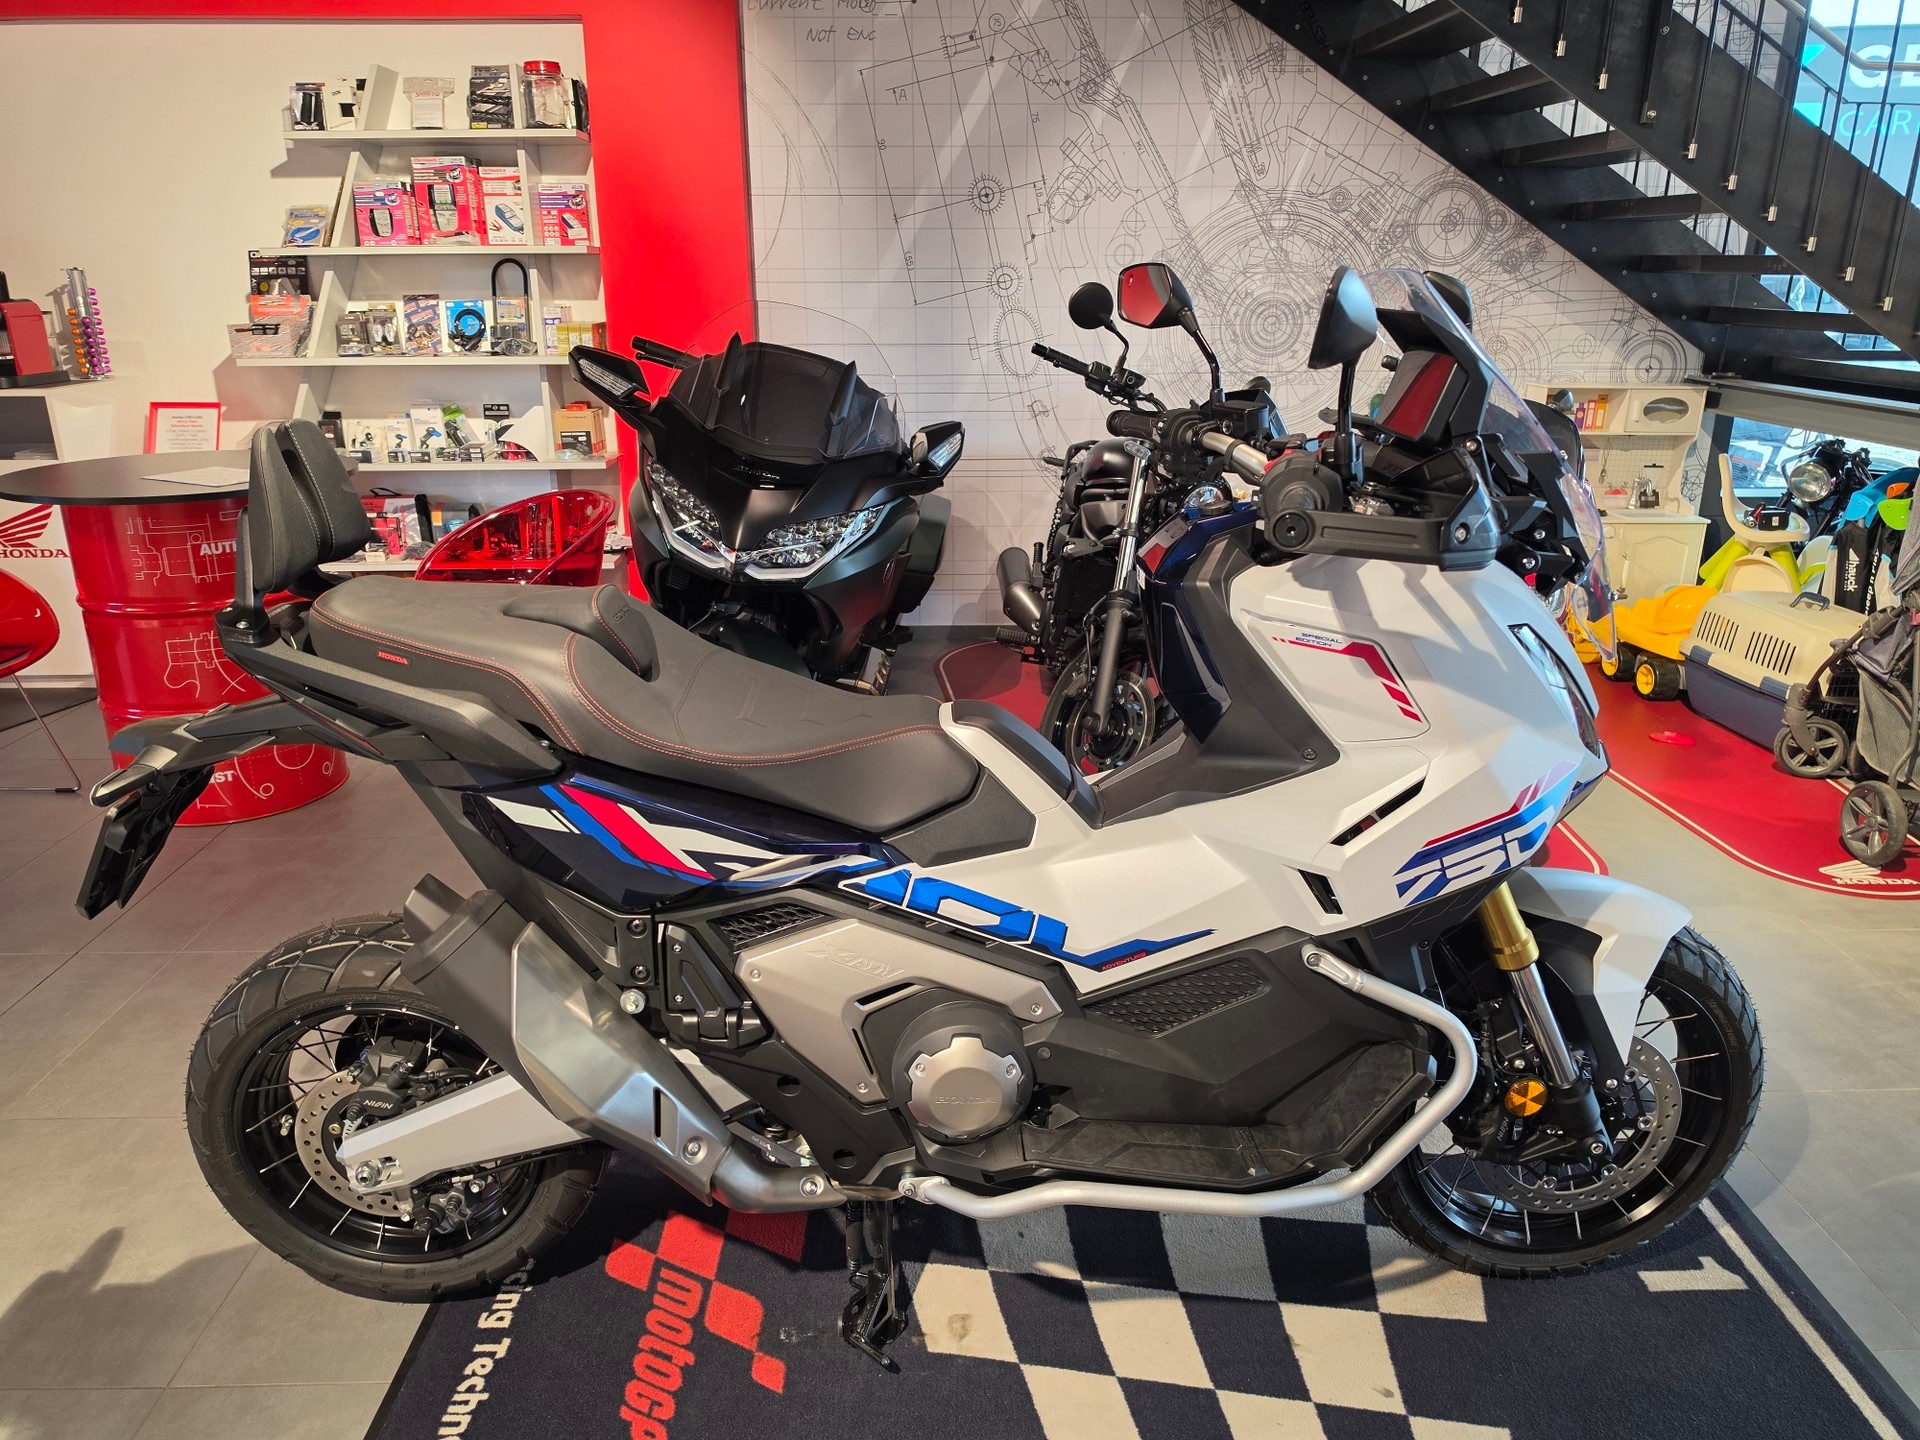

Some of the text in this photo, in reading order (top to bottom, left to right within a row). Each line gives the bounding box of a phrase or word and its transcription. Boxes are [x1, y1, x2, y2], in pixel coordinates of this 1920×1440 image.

[898, 88, 908, 101] A
[0, 548, 71, 559] HONDA
[1846, 560, 1860, 592] hauck
[1295, 636, 1332, 647] EDITION
[1301, 632, 1343, 644] SPECIAL
[377, 651, 409, 666] HONDA
[436, 1336, 512, 1440] Techn
